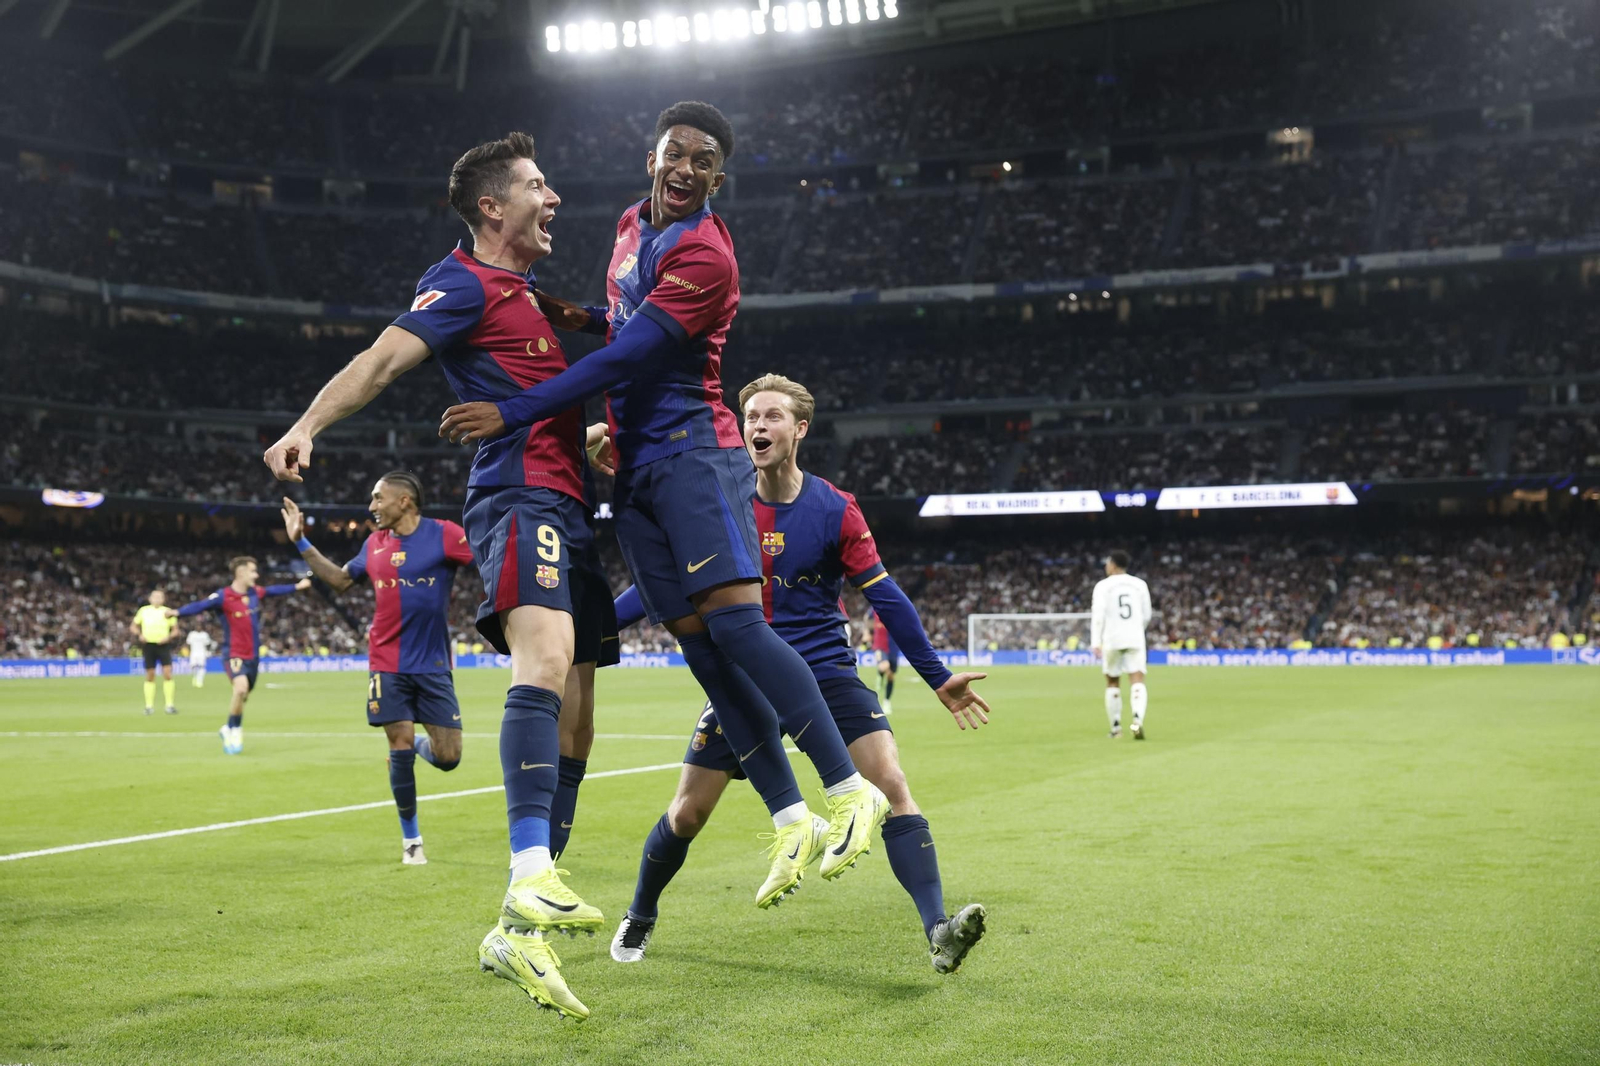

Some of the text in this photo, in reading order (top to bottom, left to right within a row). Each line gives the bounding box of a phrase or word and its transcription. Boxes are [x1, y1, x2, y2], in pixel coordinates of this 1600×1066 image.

[663, 272, 700, 293] AMBILIGHT
[1232, 490, 1302, 502] BARCELONA
[537, 524, 561, 562] 9
[1118, 594, 1131, 619] 5
[1166, 650, 1504, 666] Nuevo servicio digital Chequea tu salud
[48, 663, 64, 677] tu
[65, 661, 100, 677] salud
[369, 673, 382, 699] 11
